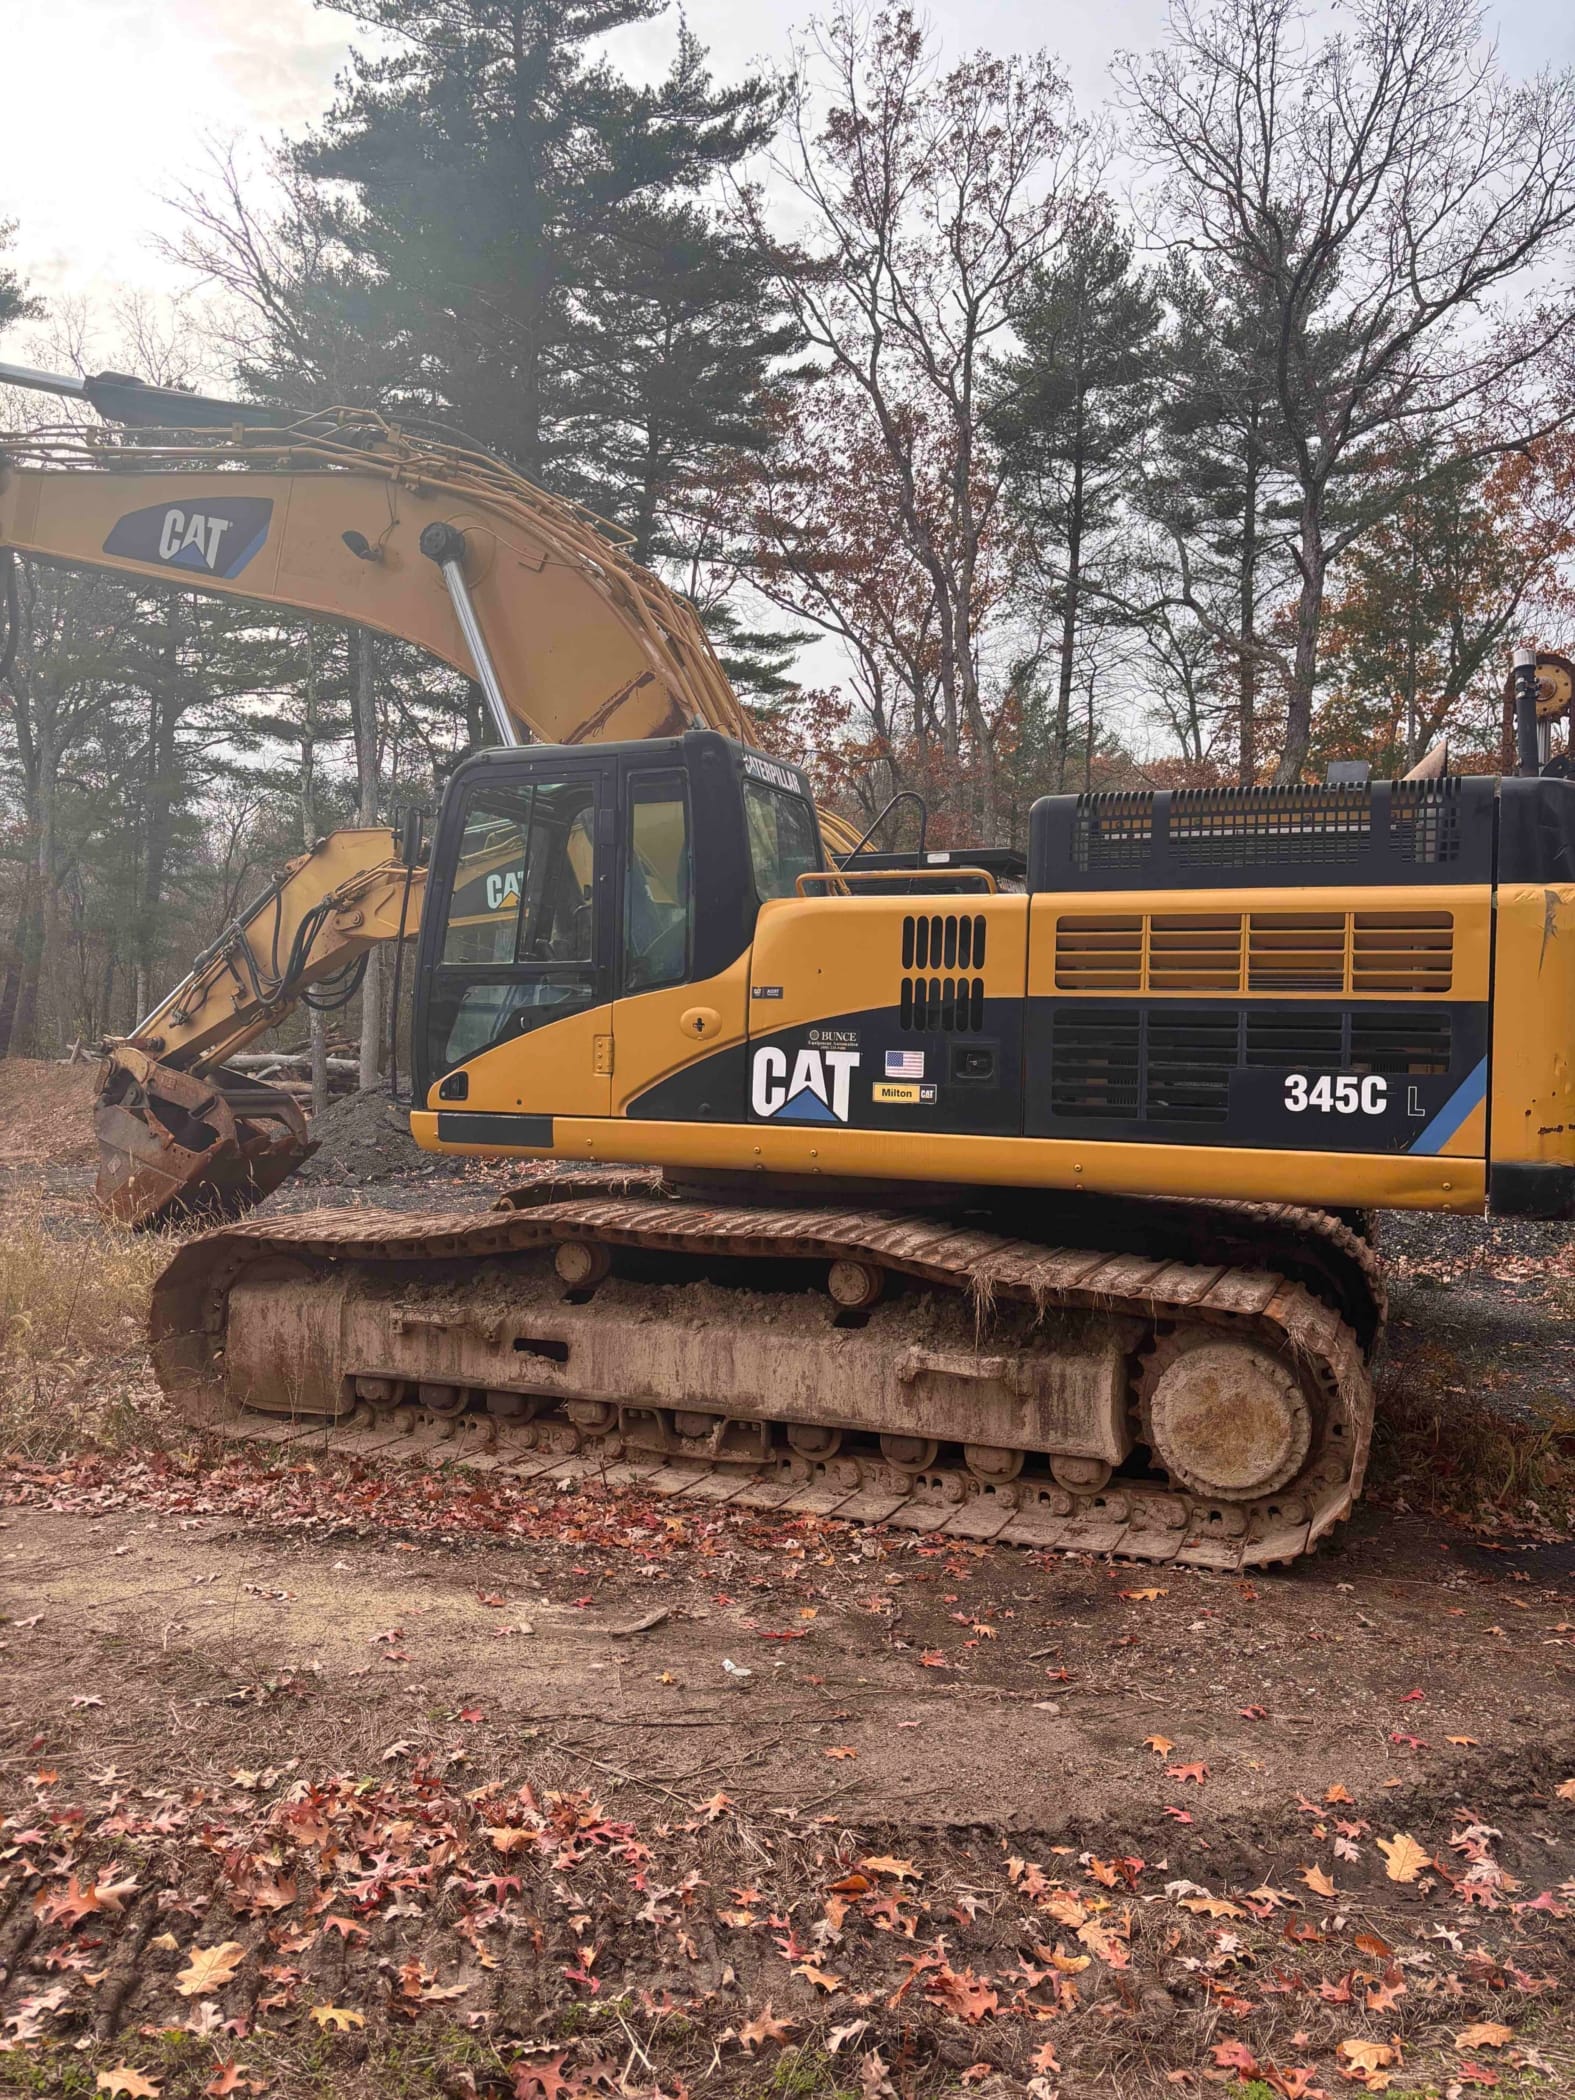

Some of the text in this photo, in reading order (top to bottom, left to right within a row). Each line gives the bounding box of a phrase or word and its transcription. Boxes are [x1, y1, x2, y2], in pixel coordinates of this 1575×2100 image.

[159, 508, 229, 569] CAT
[742, 752, 801, 793] CATERPILLAR
[821, 1031, 857, 1042] BUNCE
[752, 1046, 860, 1122] CAT
[881, 1088, 934, 1099] Milton CAT
[1284, 1074, 1425, 1117] 345C L
